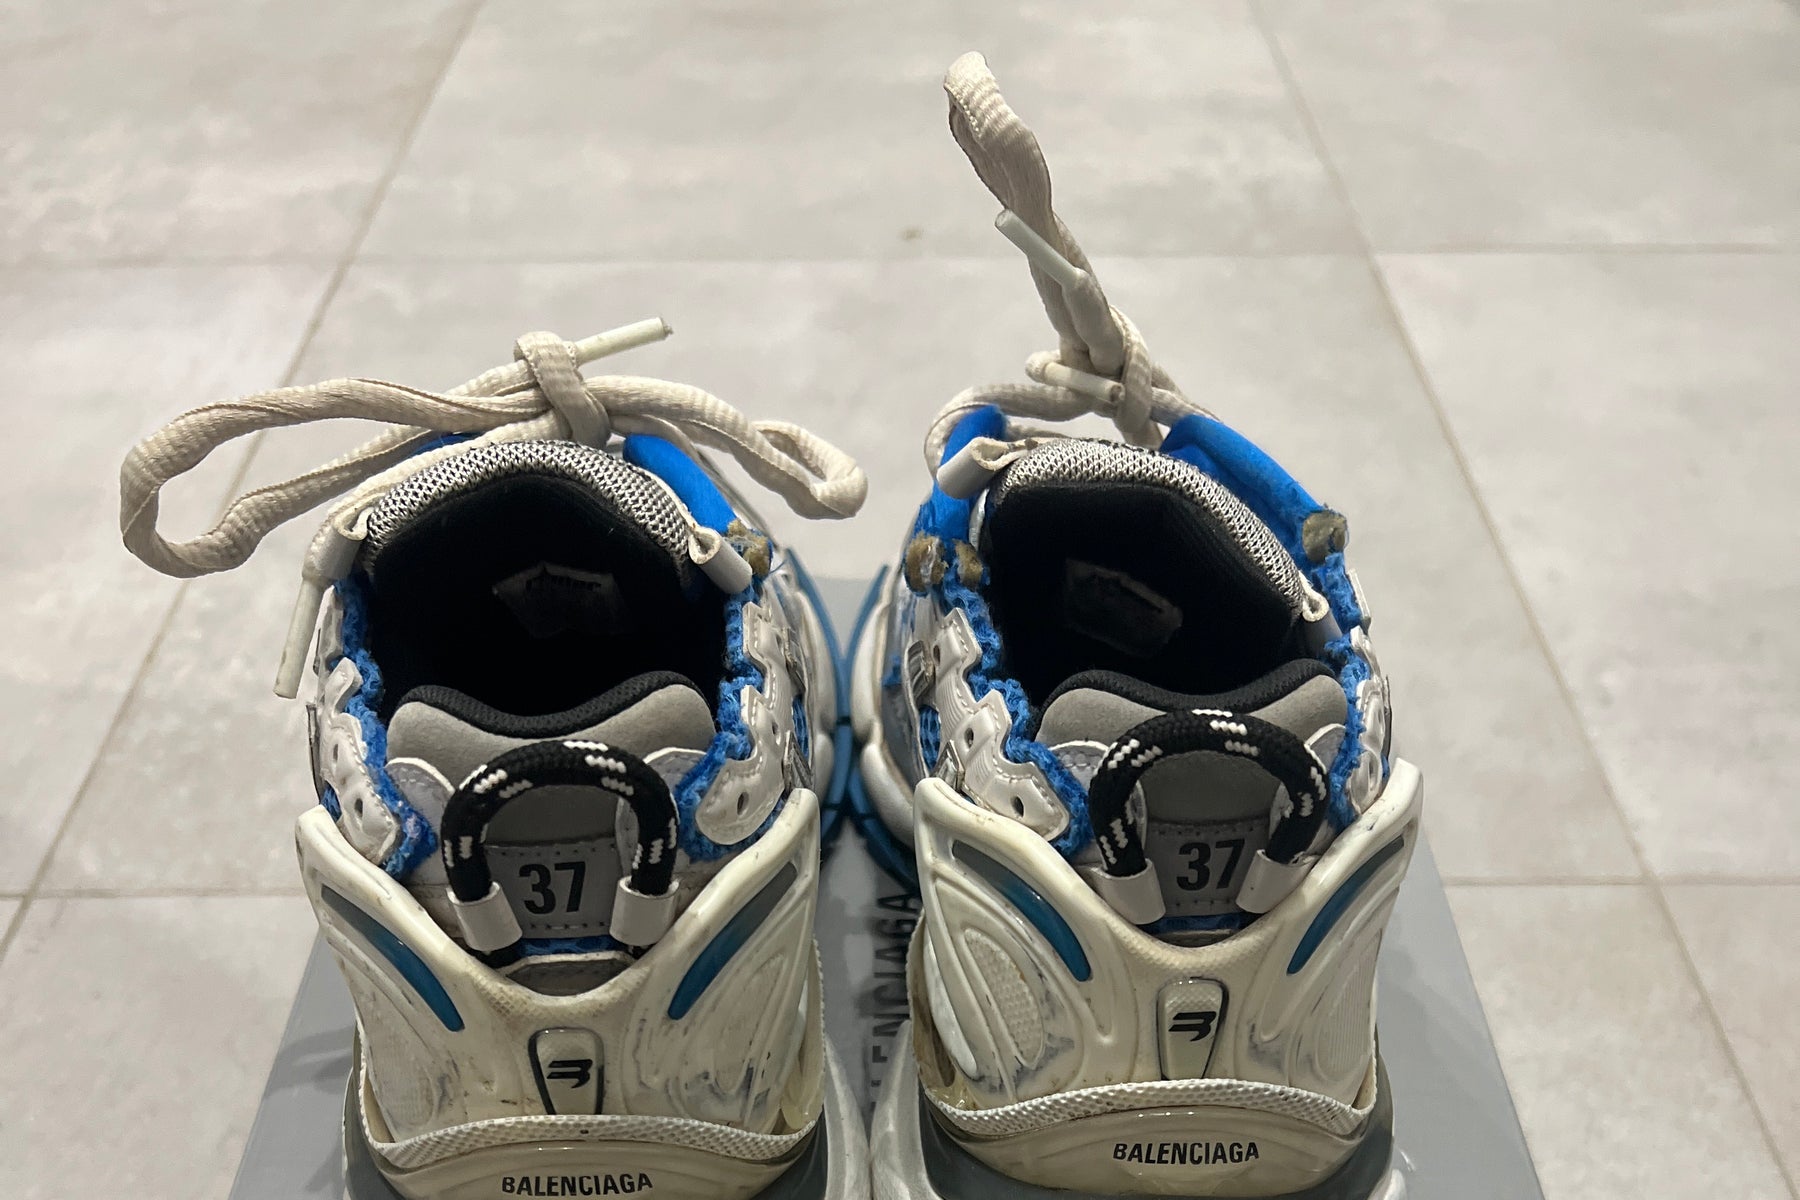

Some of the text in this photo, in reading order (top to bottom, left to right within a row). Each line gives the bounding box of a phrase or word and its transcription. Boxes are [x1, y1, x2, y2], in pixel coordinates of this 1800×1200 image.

[519, 861, 585, 914] 37
[1176, 838, 1245, 891] 37
[870, 893, 922, 1112] NCIAGA
[1113, 1142, 1260, 1165] BALENCIAGA
[502, 1173, 653, 1196] BALENCIAGA
